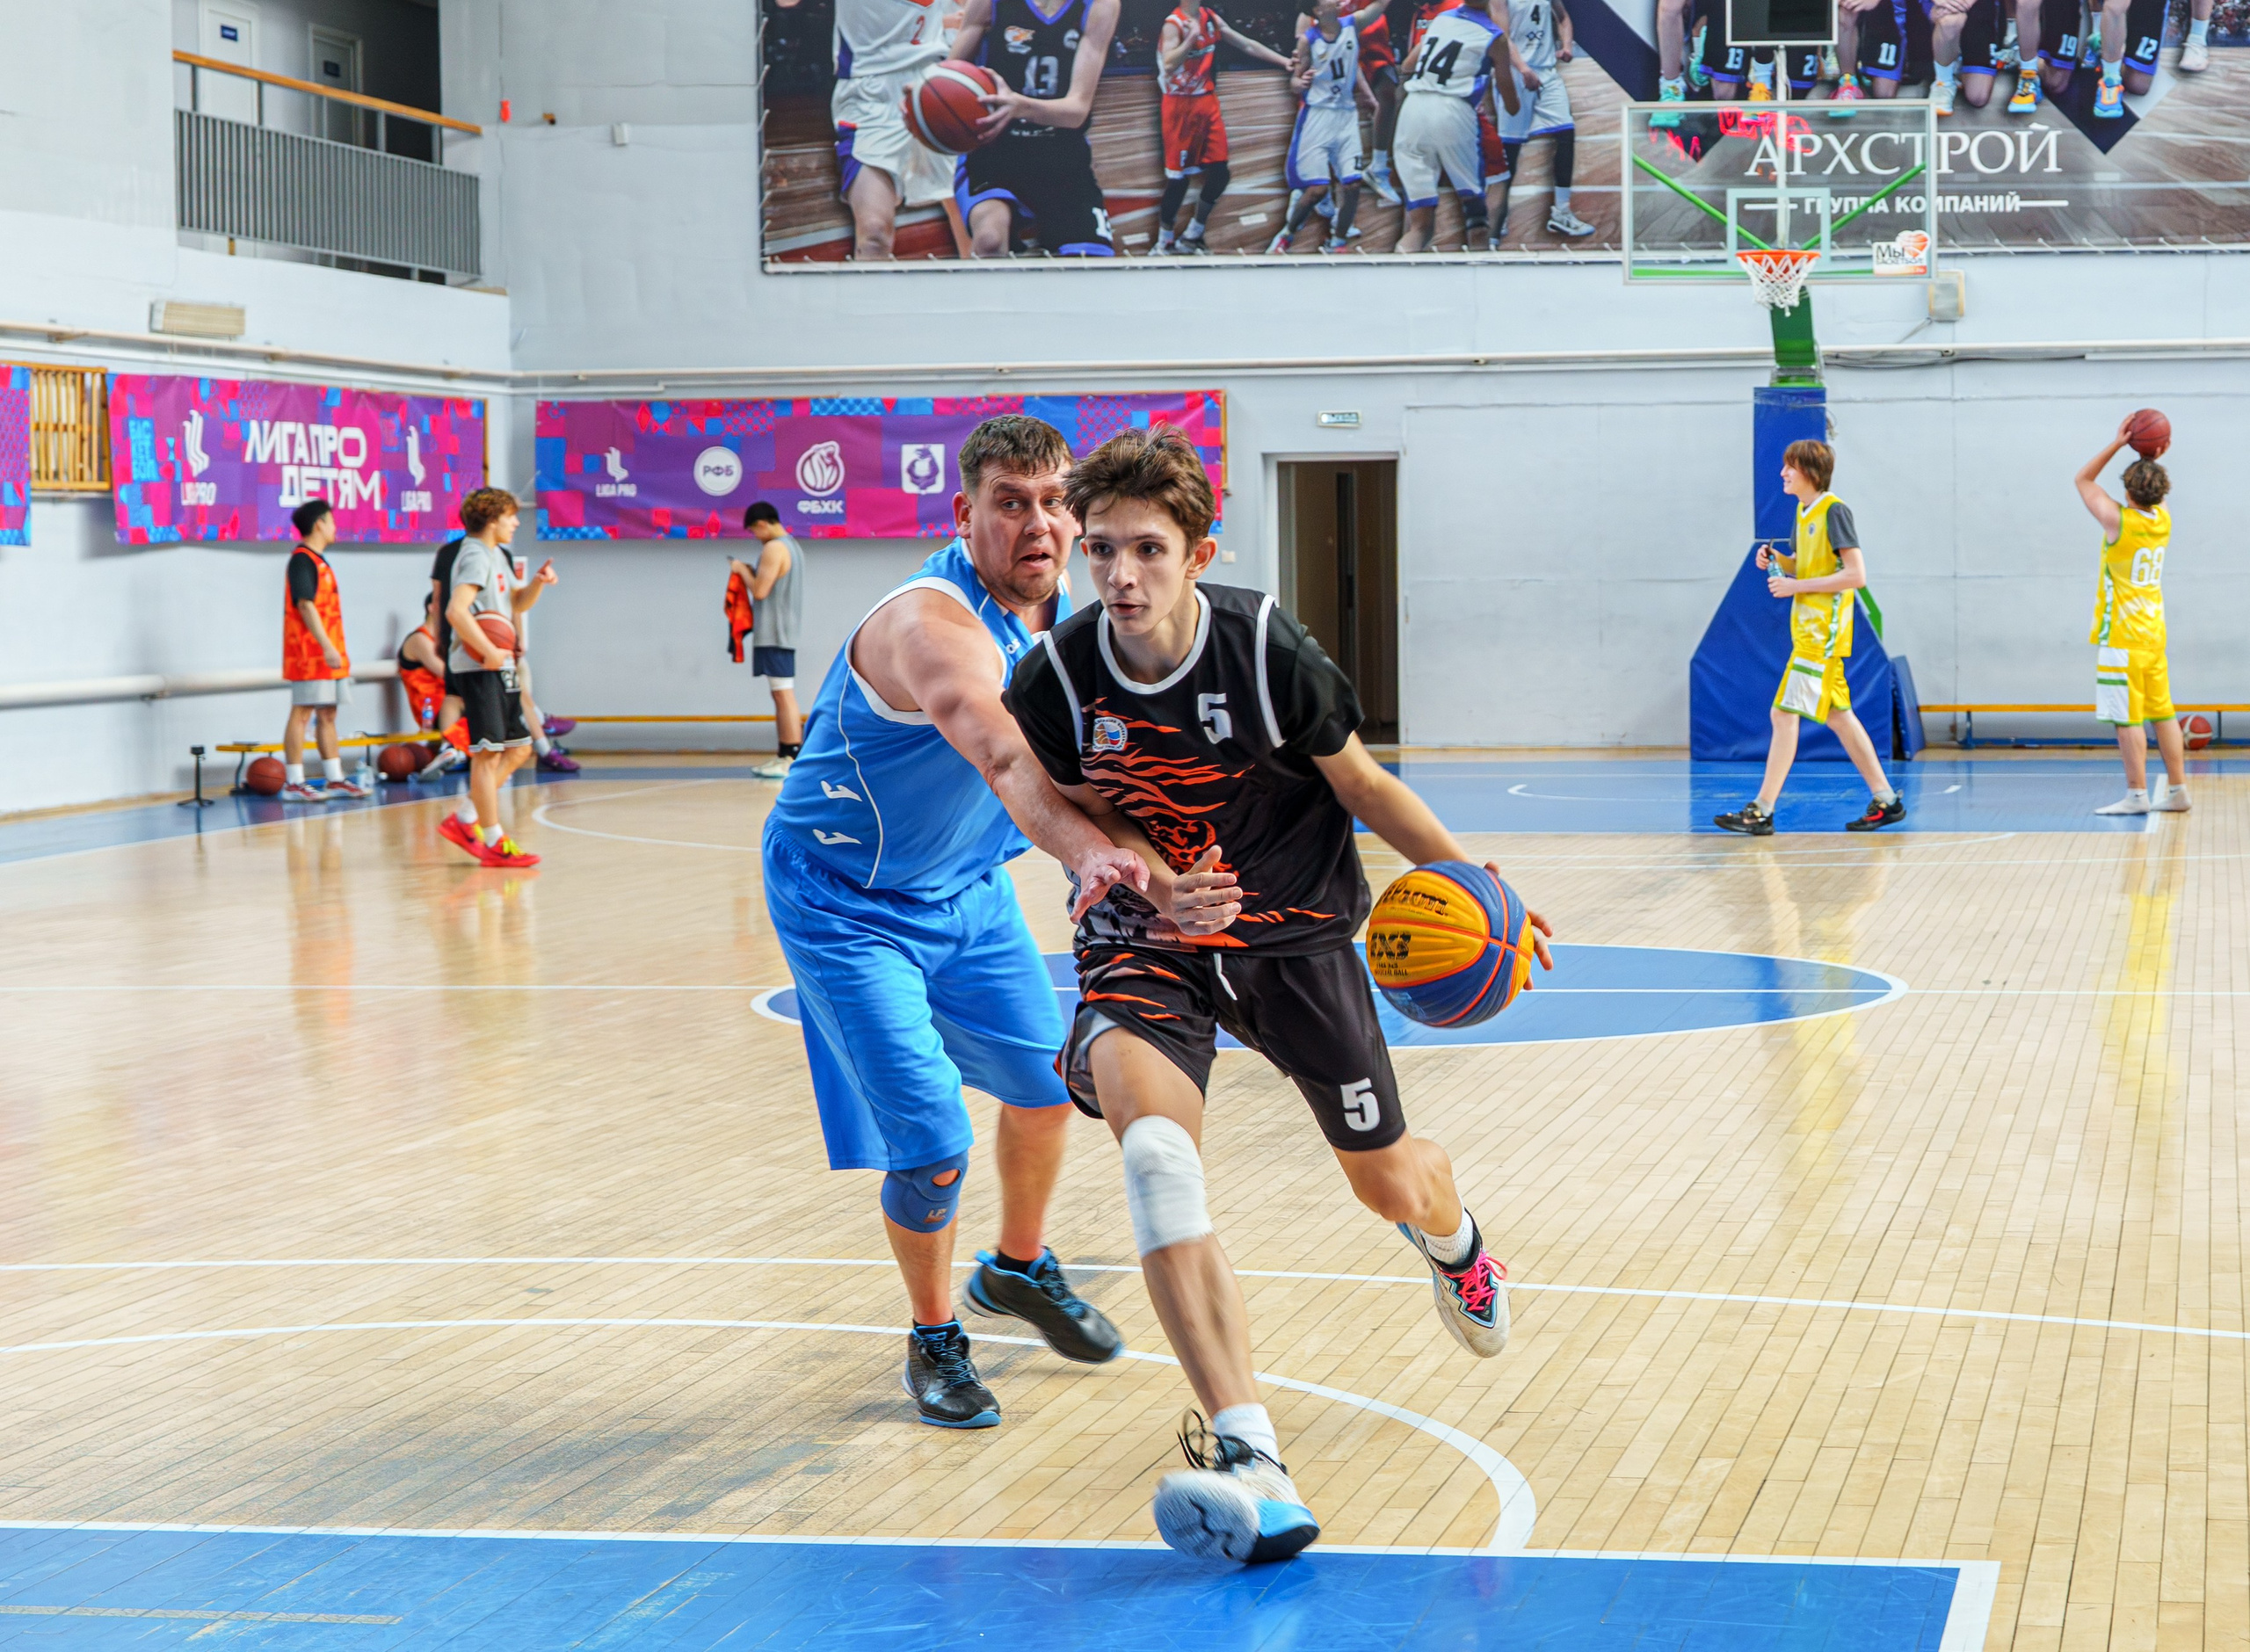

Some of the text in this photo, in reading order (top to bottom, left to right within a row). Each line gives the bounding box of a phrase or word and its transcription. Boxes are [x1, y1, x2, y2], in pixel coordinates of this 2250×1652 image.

[910, 14, 926, 46] 2
[2058, 33, 2079, 57] 19
[1724, 47, 1745, 70] 13
[1877, 42, 1898, 67] 11
[2135, 35, 2159, 61] 12
[1022, 54, 1059, 98] 13
[1744, 122, 2063, 177] АРХСТРОЙ
[703, 465, 734, 477] РФБ
[279, 465, 381, 511] ДЕТЯМ
[796, 499, 845, 515] ФБХК
[2130, 545, 2165, 588] 68
[1197, 692, 1233, 745] 5
[1339, 1076, 1381, 1132] 5
